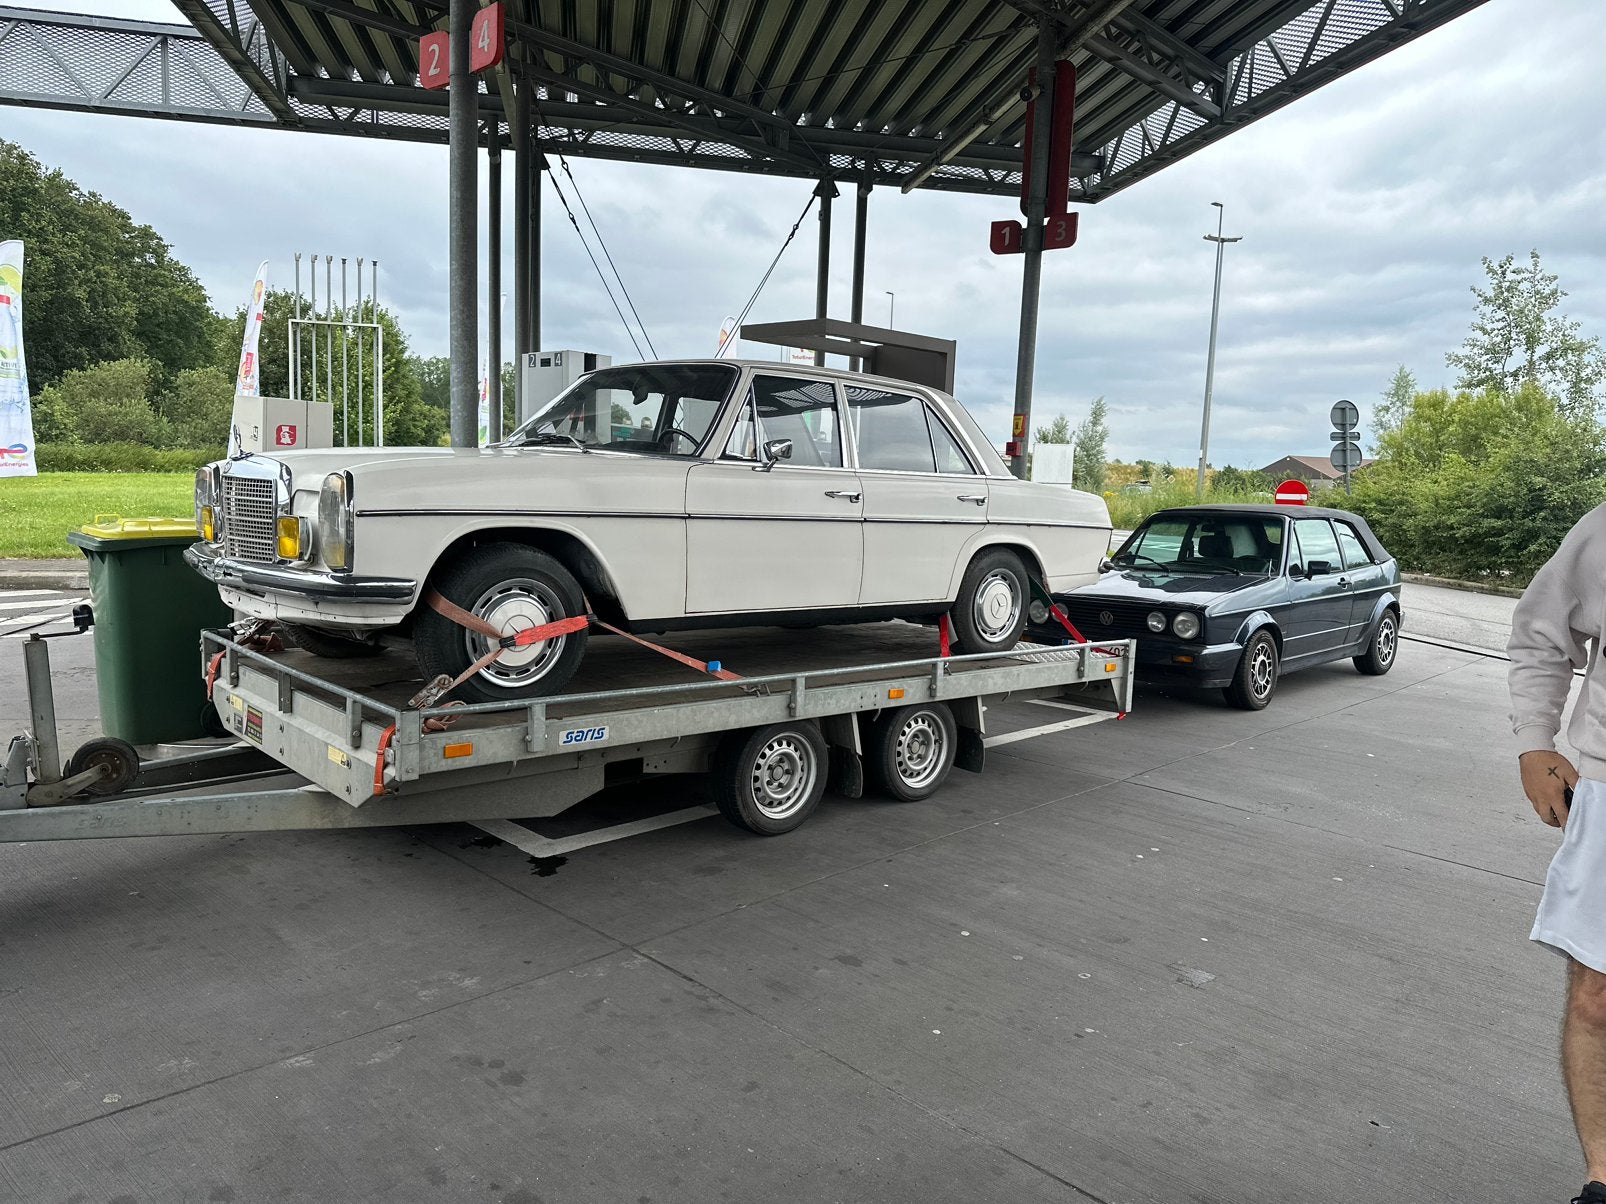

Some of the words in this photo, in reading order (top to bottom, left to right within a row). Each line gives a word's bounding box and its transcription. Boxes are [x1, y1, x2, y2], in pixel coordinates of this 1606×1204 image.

[478, 19, 490, 53] 4
[428, 43, 440, 77] 2
[1001, 226, 1010, 247] 1
[1055, 220, 1067, 241] 3
[529, 354, 535, 367] 2
[555, 353, 561, 366] 4
[562, 727, 606, 745] saris
